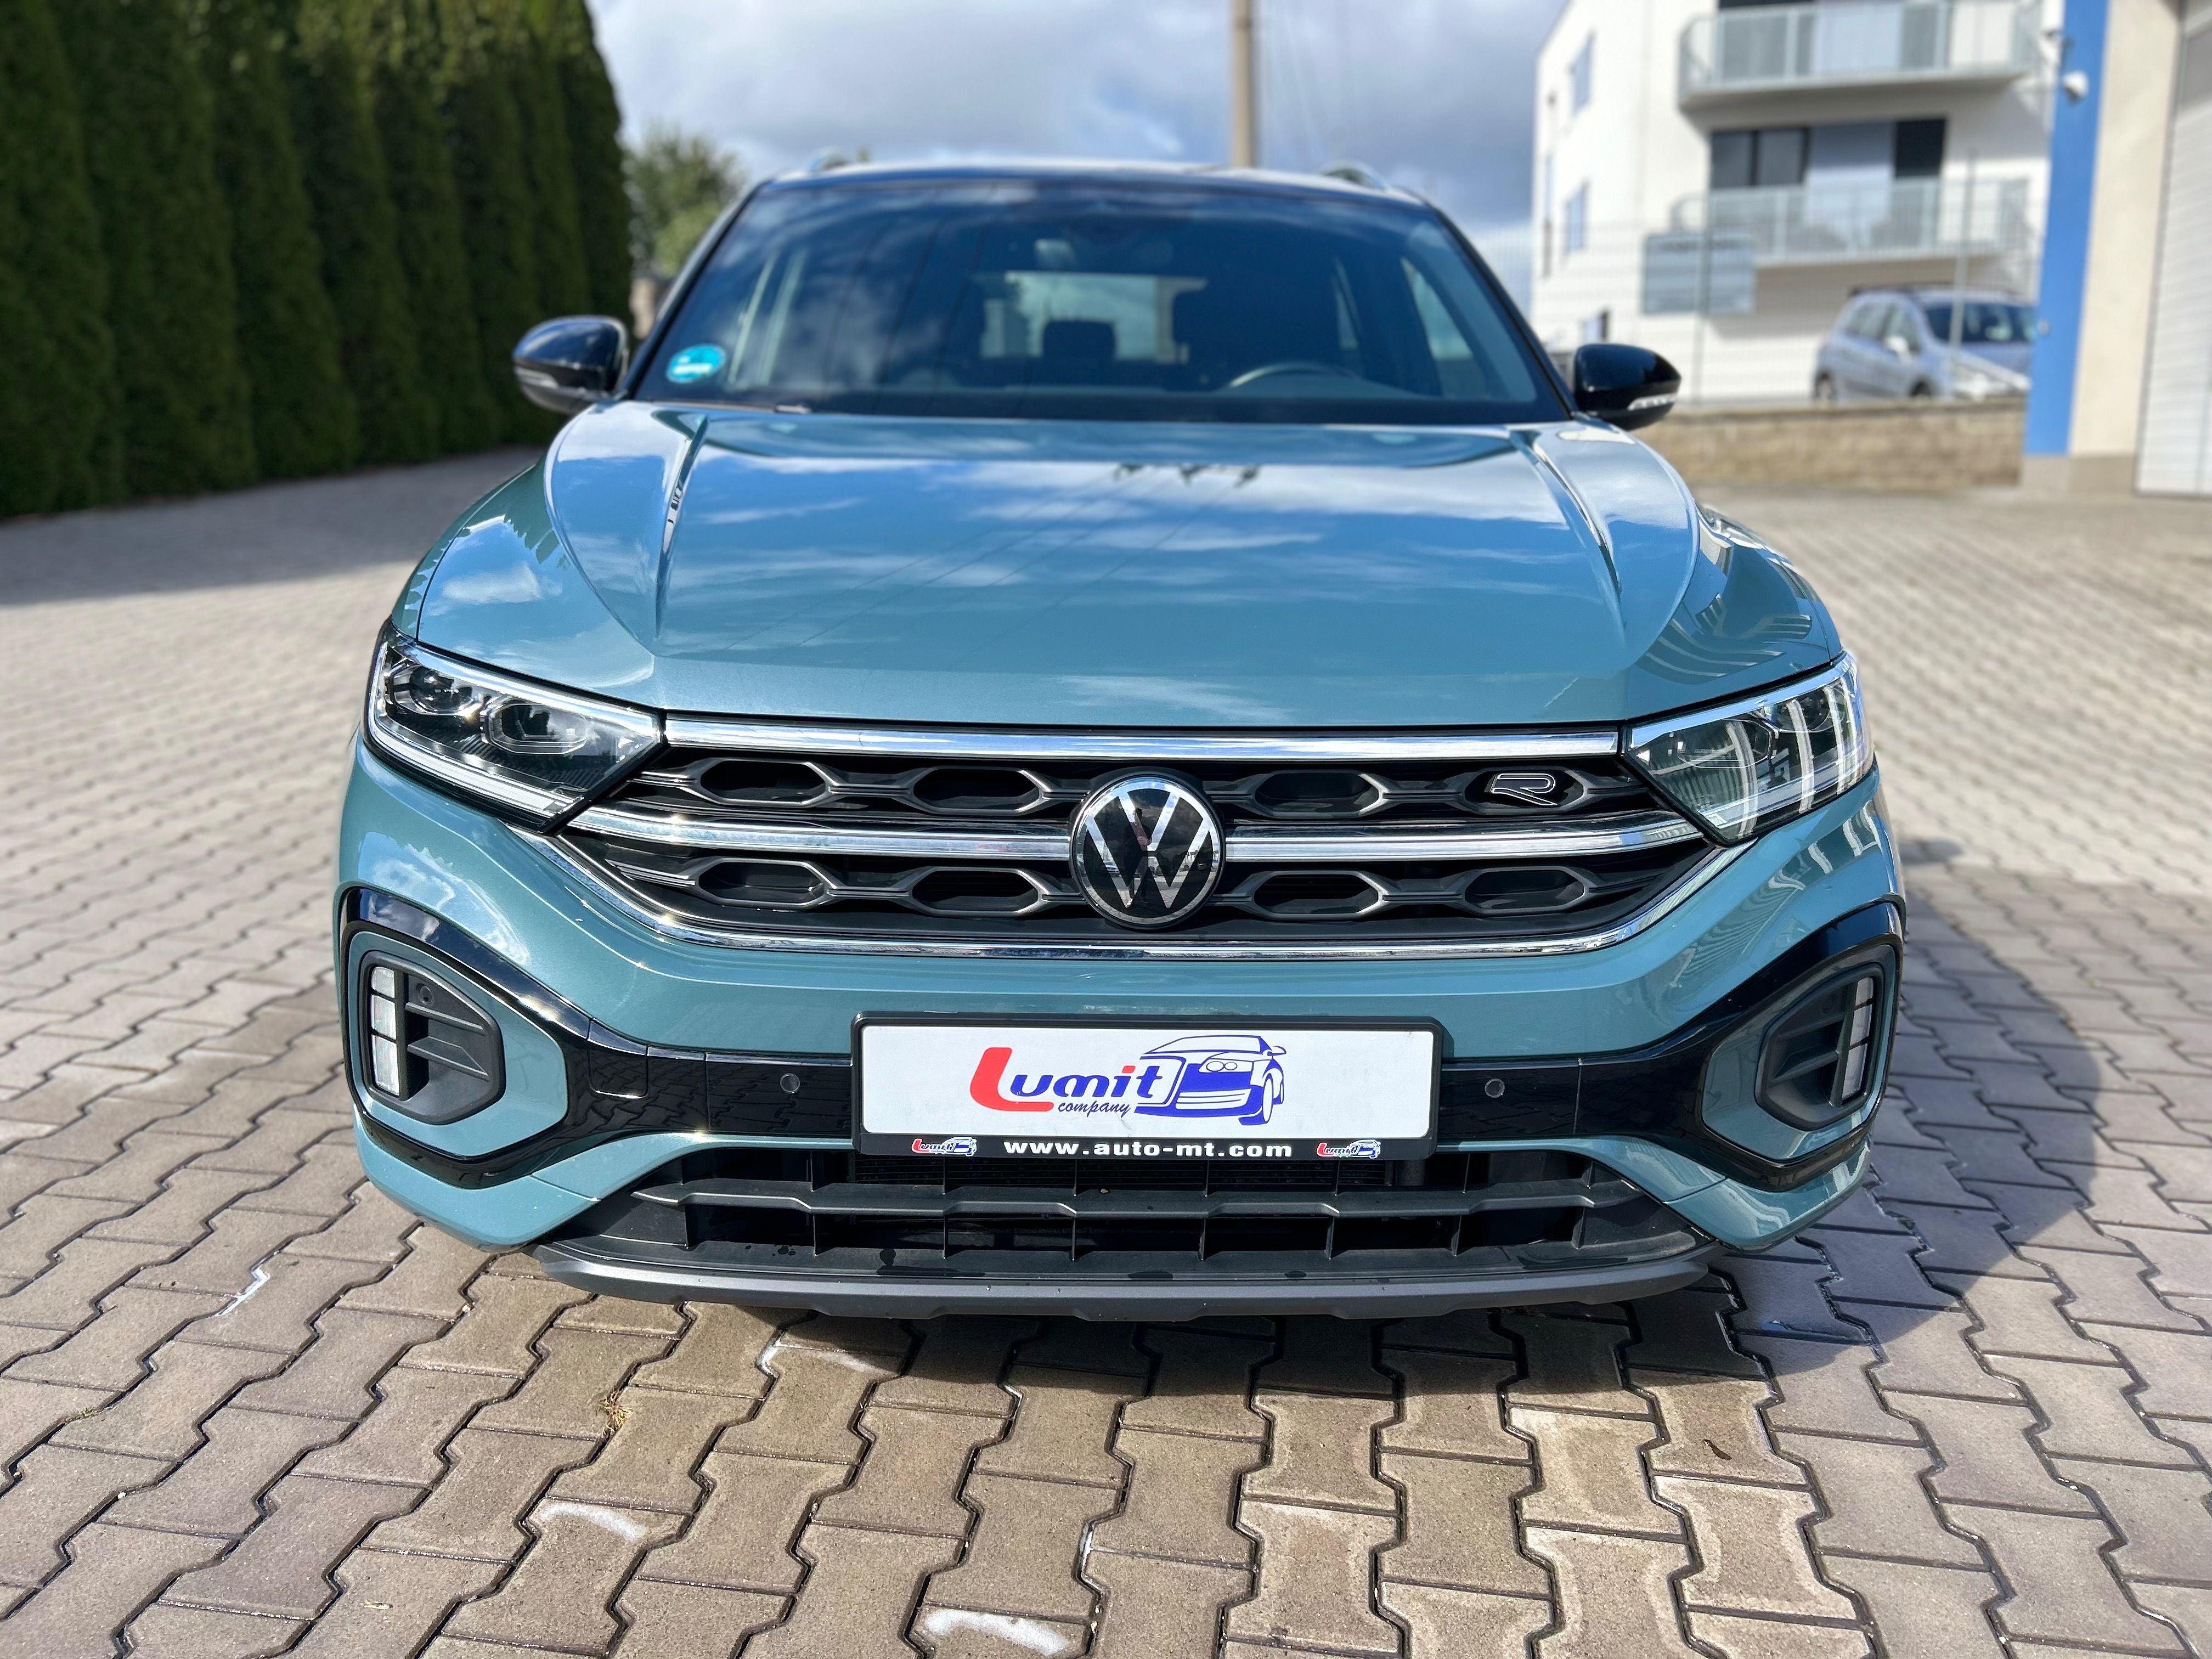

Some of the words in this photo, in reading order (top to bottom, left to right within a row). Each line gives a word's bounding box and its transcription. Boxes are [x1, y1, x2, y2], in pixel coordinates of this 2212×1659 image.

[1491, 773, 1558, 806] R
[1082, 780, 1216, 910] VW
[969, 1047, 1163, 1112] Lumit
[1057, 1099, 1132, 1118] company
[1003, 1141, 1293, 1158] www.auto-mt.com
